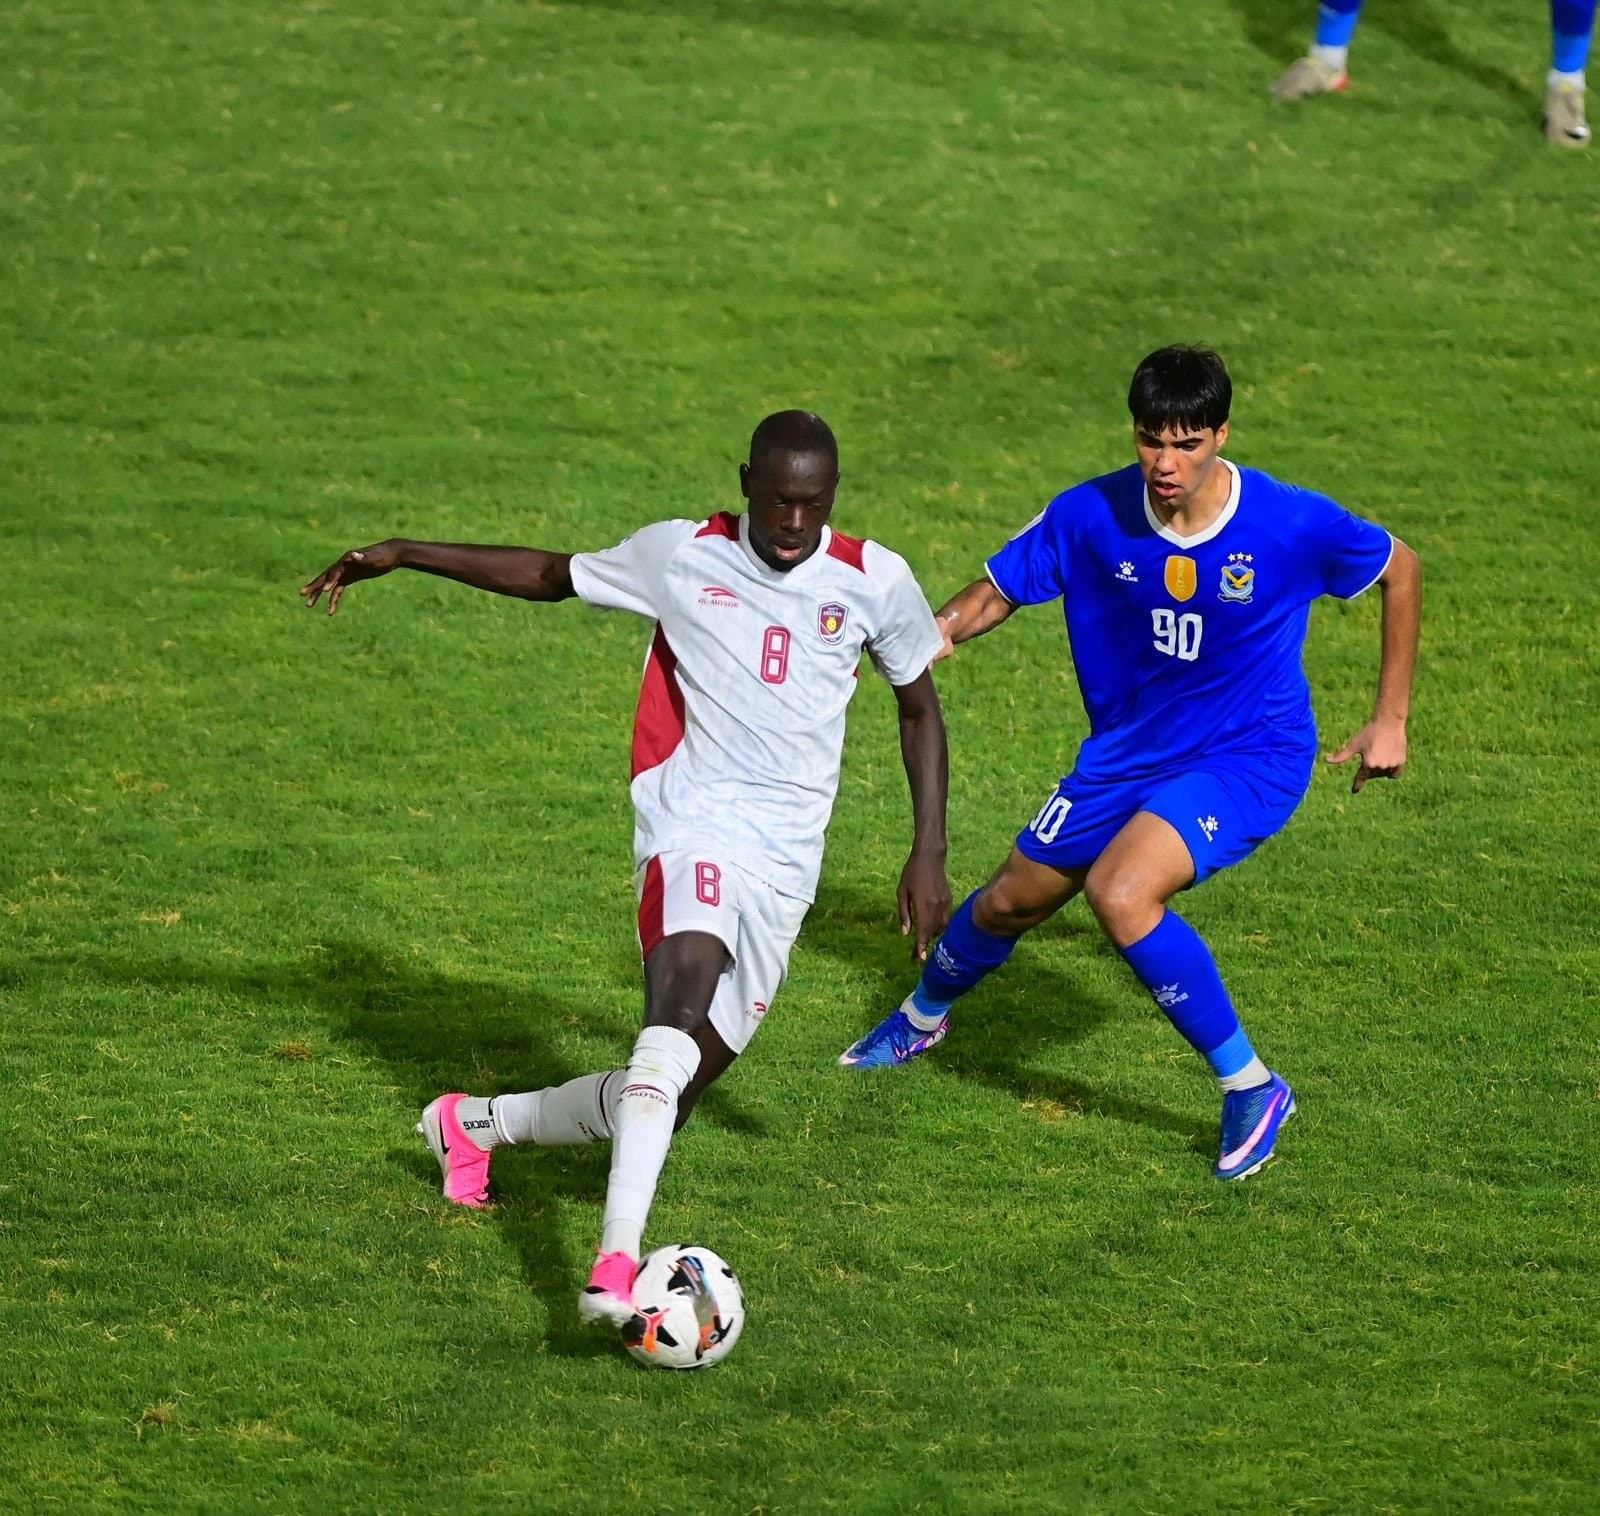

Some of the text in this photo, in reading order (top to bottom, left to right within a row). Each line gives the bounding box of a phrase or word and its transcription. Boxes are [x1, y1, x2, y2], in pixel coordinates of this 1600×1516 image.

[761, 625, 791, 684] 8
[1151, 608, 1203, 662] 90
[695, 861, 721, 907] 8
[463, 1119, 490, 1130] SOCKS
